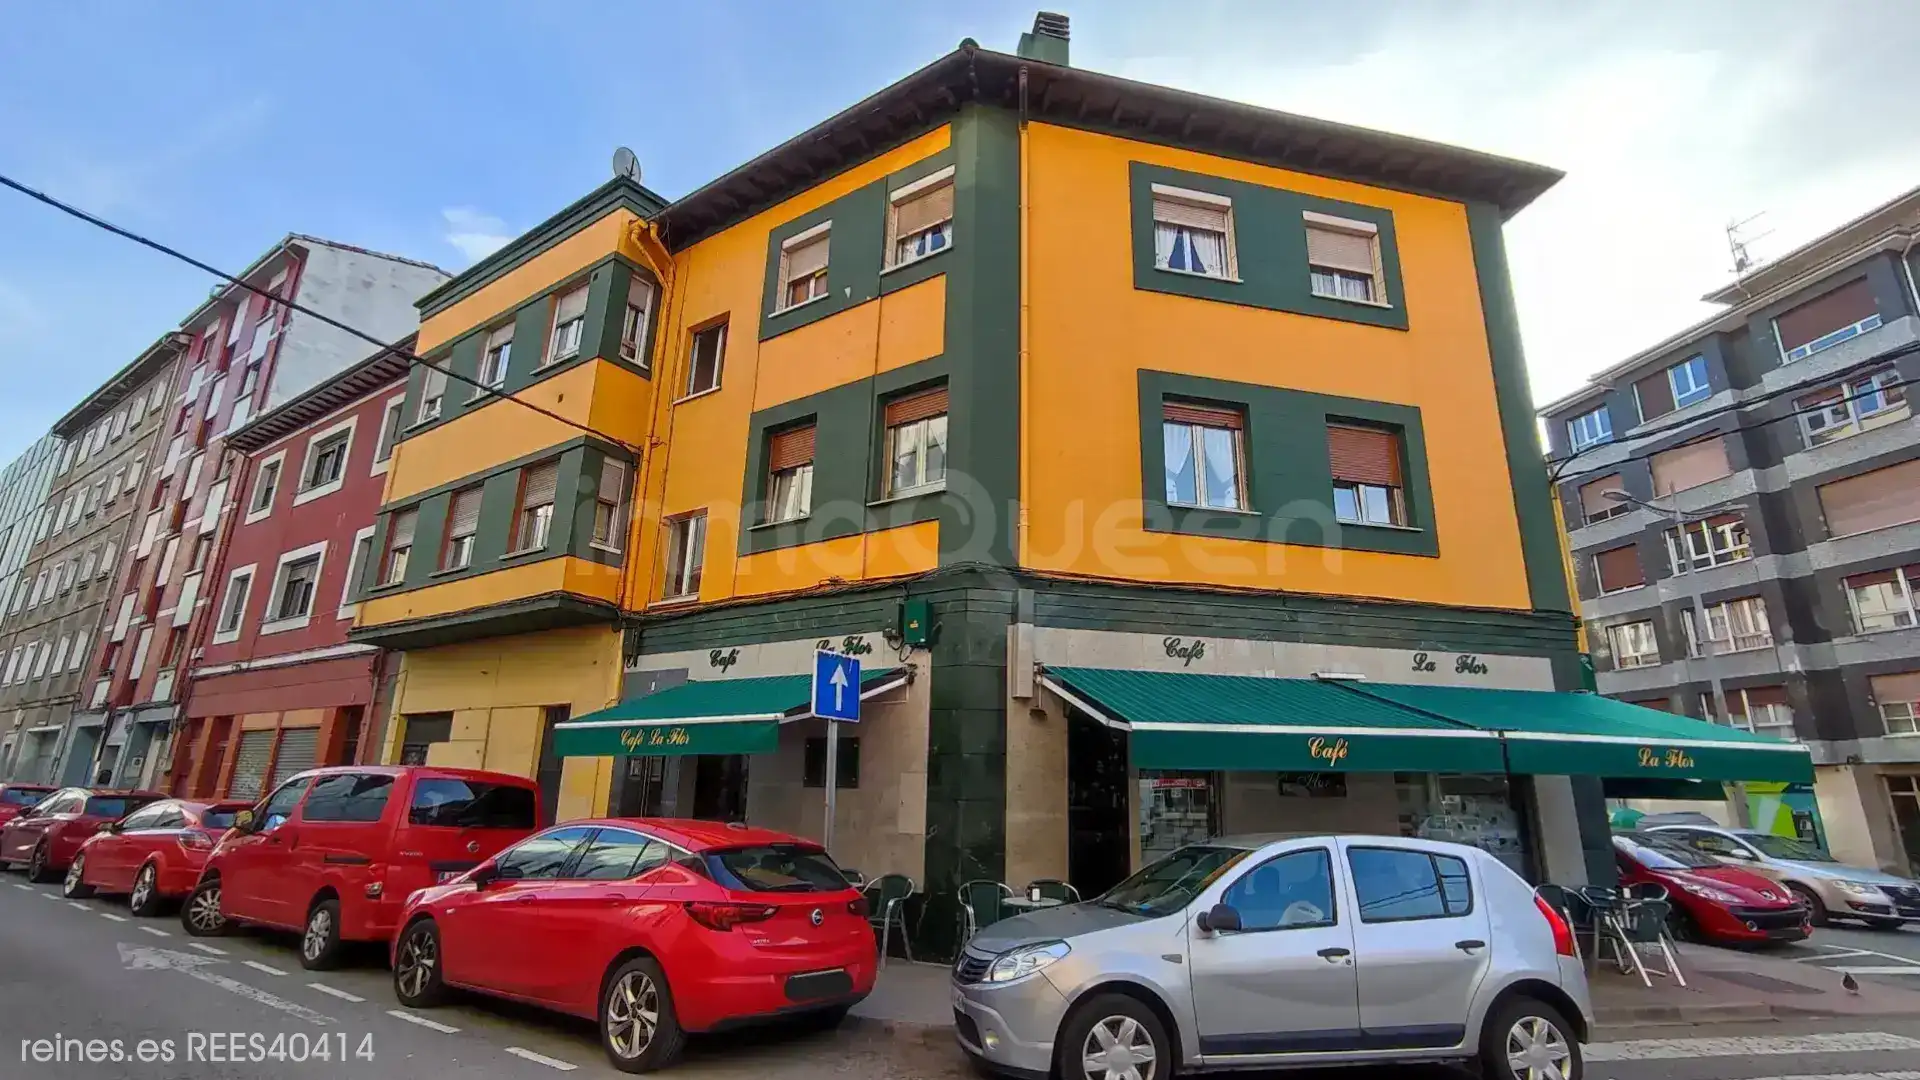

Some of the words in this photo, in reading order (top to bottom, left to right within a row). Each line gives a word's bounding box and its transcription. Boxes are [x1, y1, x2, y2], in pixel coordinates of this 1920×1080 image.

[710, 648, 740, 673] Café
[841, 635, 873, 655] Flor
[1163, 636, 1206, 667] Café
[1412, 652, 1436, 672] La
[1455, 654, 1488, 674] Flor
[620, 728, 646, 752] Café
[648, 728, 664, 746] La
[667, 728, 690, 745] Flor
[1307, 736, 1349, 767] Café
[1638, 747, 1660, 767] La
[1664, 749, 1695, 768] Flor
